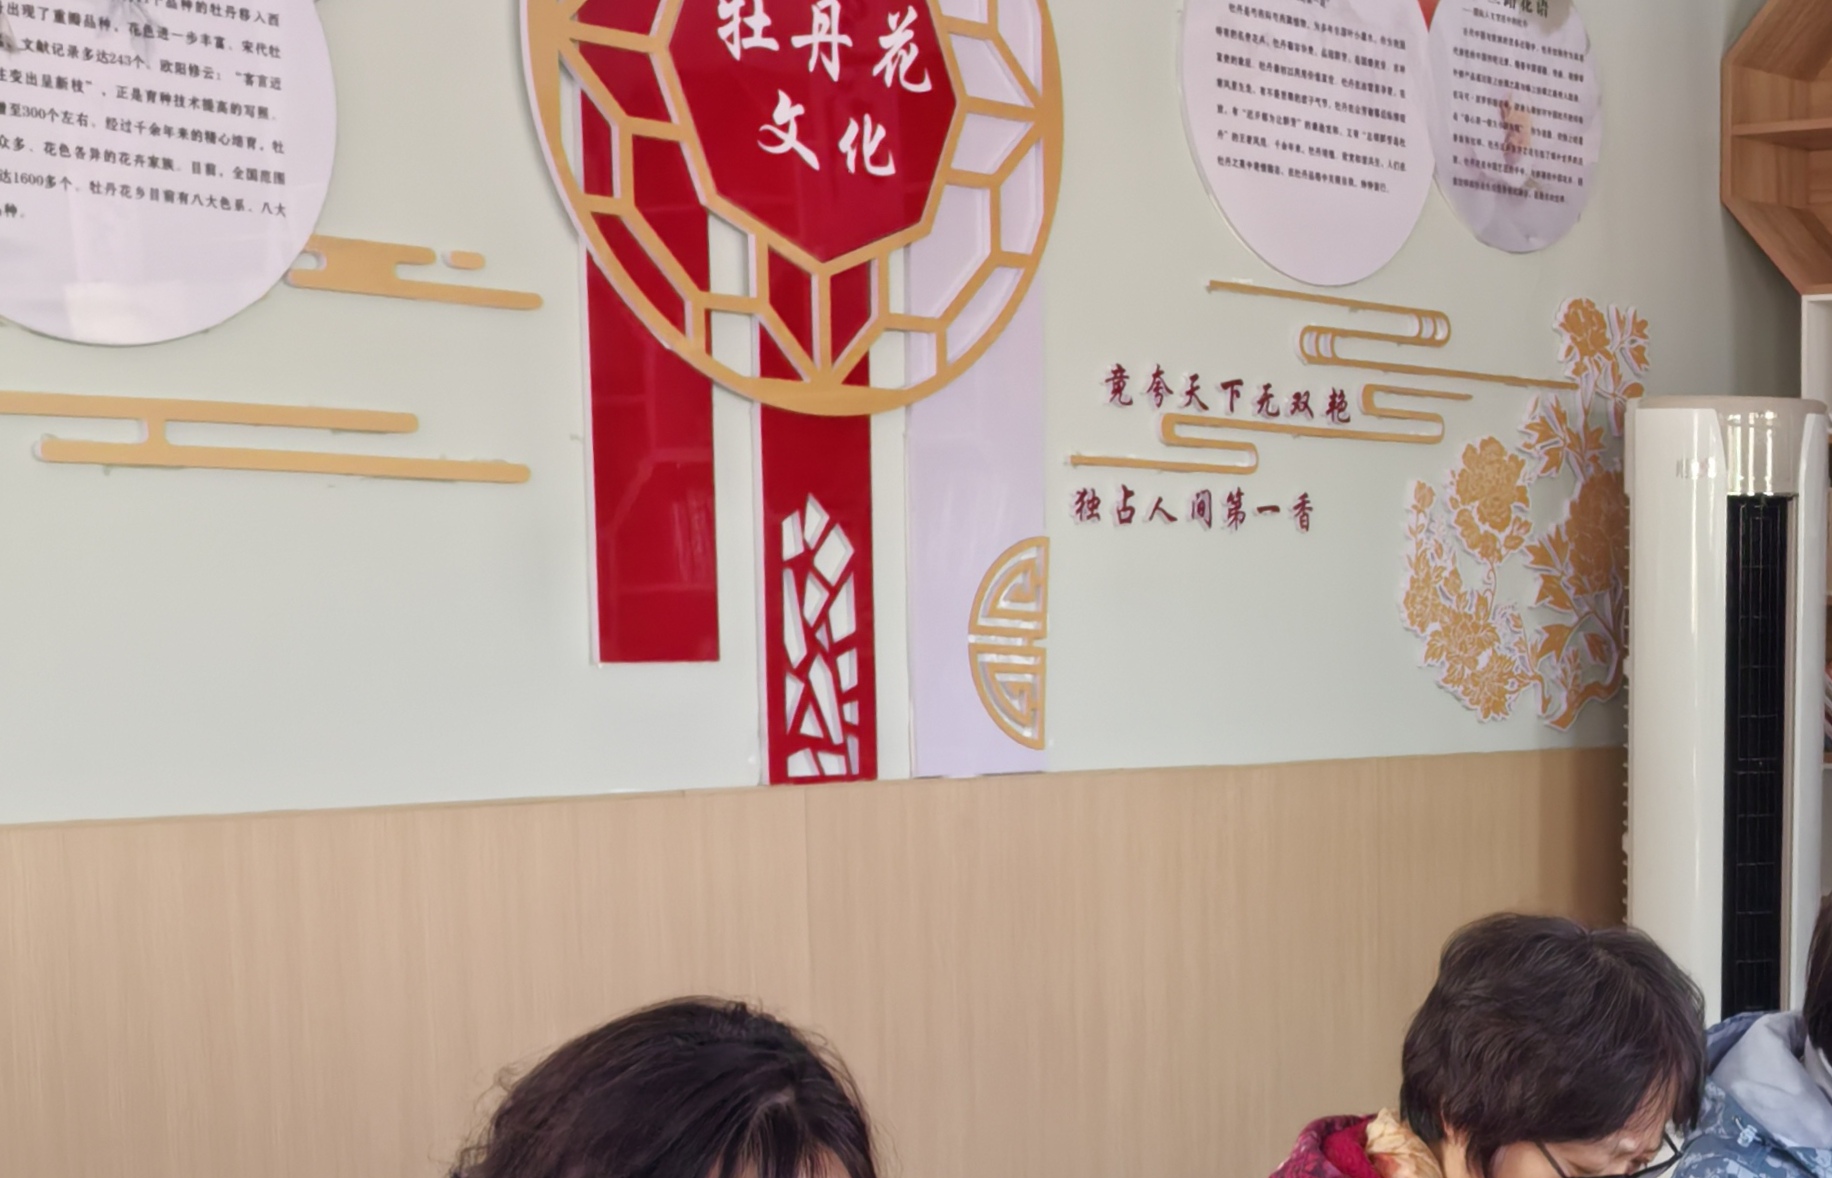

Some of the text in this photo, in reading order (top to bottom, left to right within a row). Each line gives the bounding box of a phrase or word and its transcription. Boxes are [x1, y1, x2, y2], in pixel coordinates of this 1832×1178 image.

[716, 0, 932, 93] 牡丹花
[757, 90, 896, 176] 文化
[1105, 364, 1351, 424] 竟夸天下无双艳
[1074, 484, 1314, 533] 独占人间第一香
